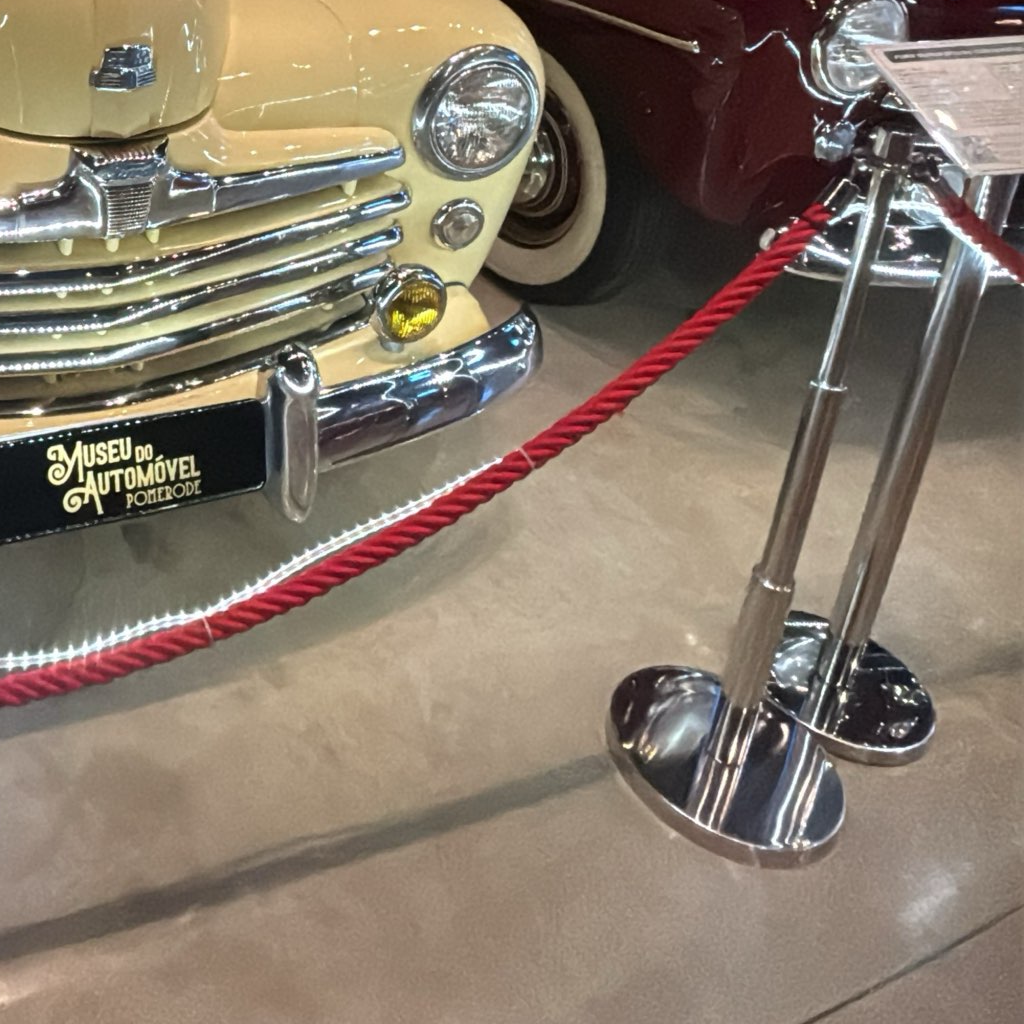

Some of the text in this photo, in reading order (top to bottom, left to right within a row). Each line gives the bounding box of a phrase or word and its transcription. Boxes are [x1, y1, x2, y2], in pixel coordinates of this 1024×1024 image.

[47, 437, 153, 485] MUSEU DO
[63, 454, 201, 515] AUTOMÓVEL
[126, 480, 202, 508] POMERODE
